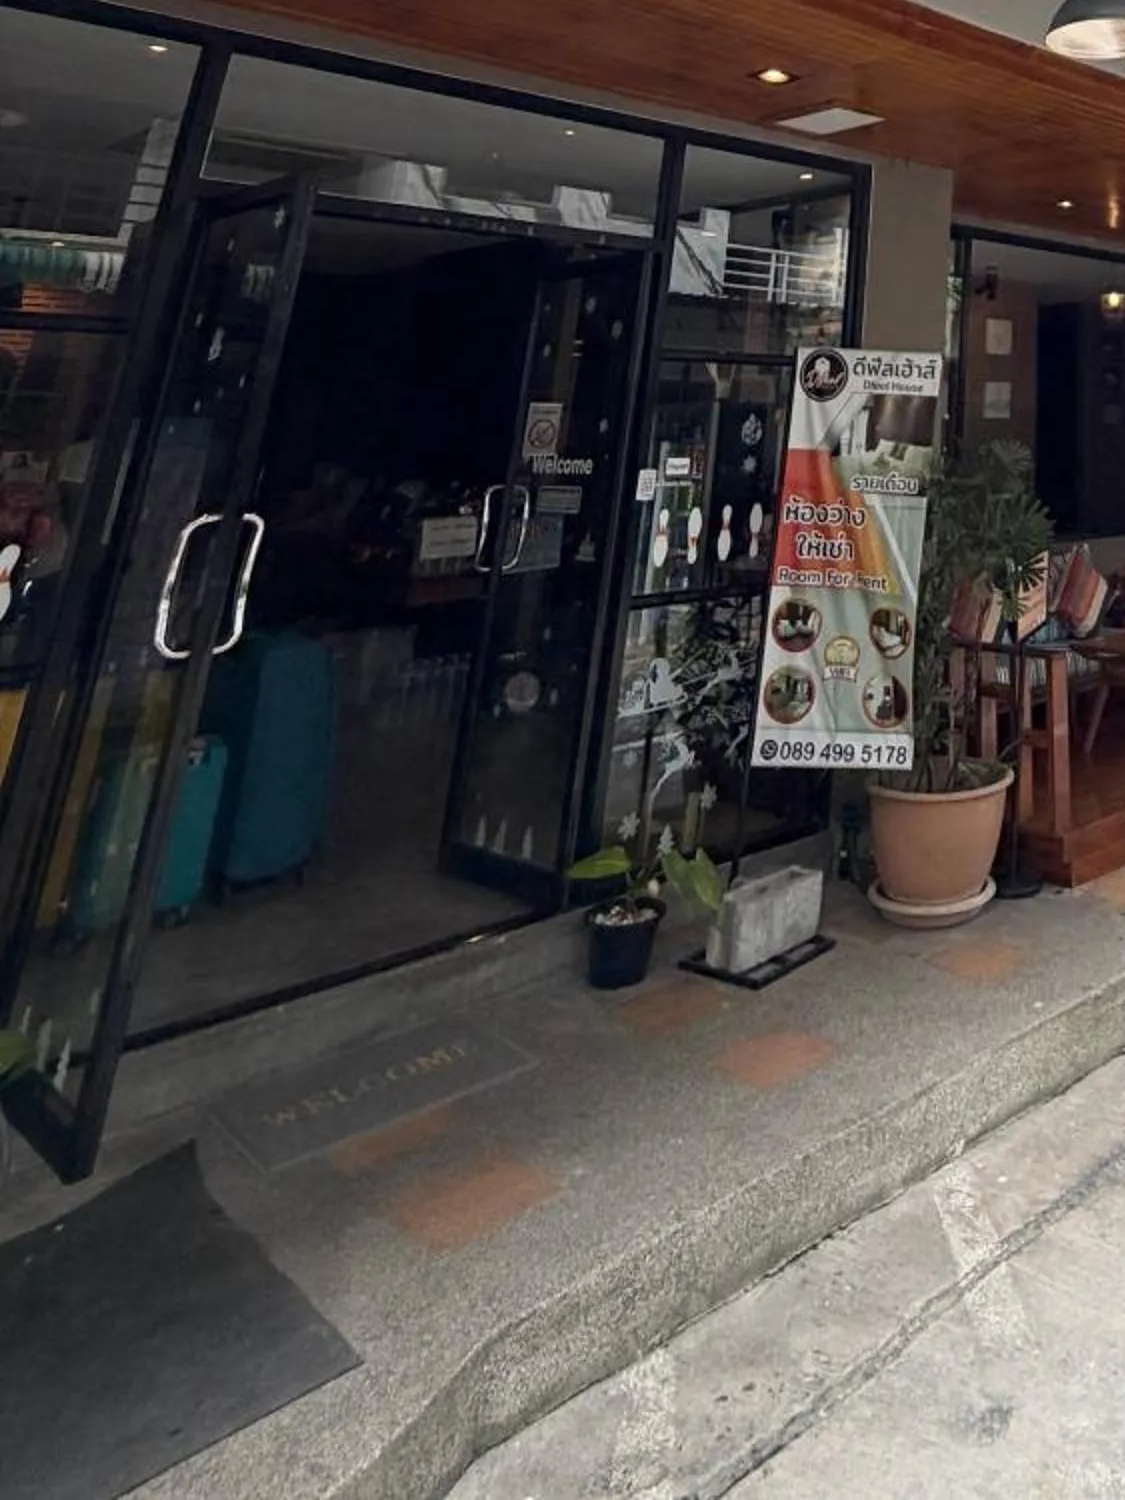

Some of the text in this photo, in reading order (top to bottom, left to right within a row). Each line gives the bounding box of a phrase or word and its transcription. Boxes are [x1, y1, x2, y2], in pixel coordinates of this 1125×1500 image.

[531, 454, 593, 475] Welcome
[784, 497, 866, 528] ห้องว่าง
[796, 532, 855, 560] ให้เช่า
[779, 567, 822, 583] Room
[827, 570, 850, 586] For
[779, 741, 908, 765] 089 499 5178
